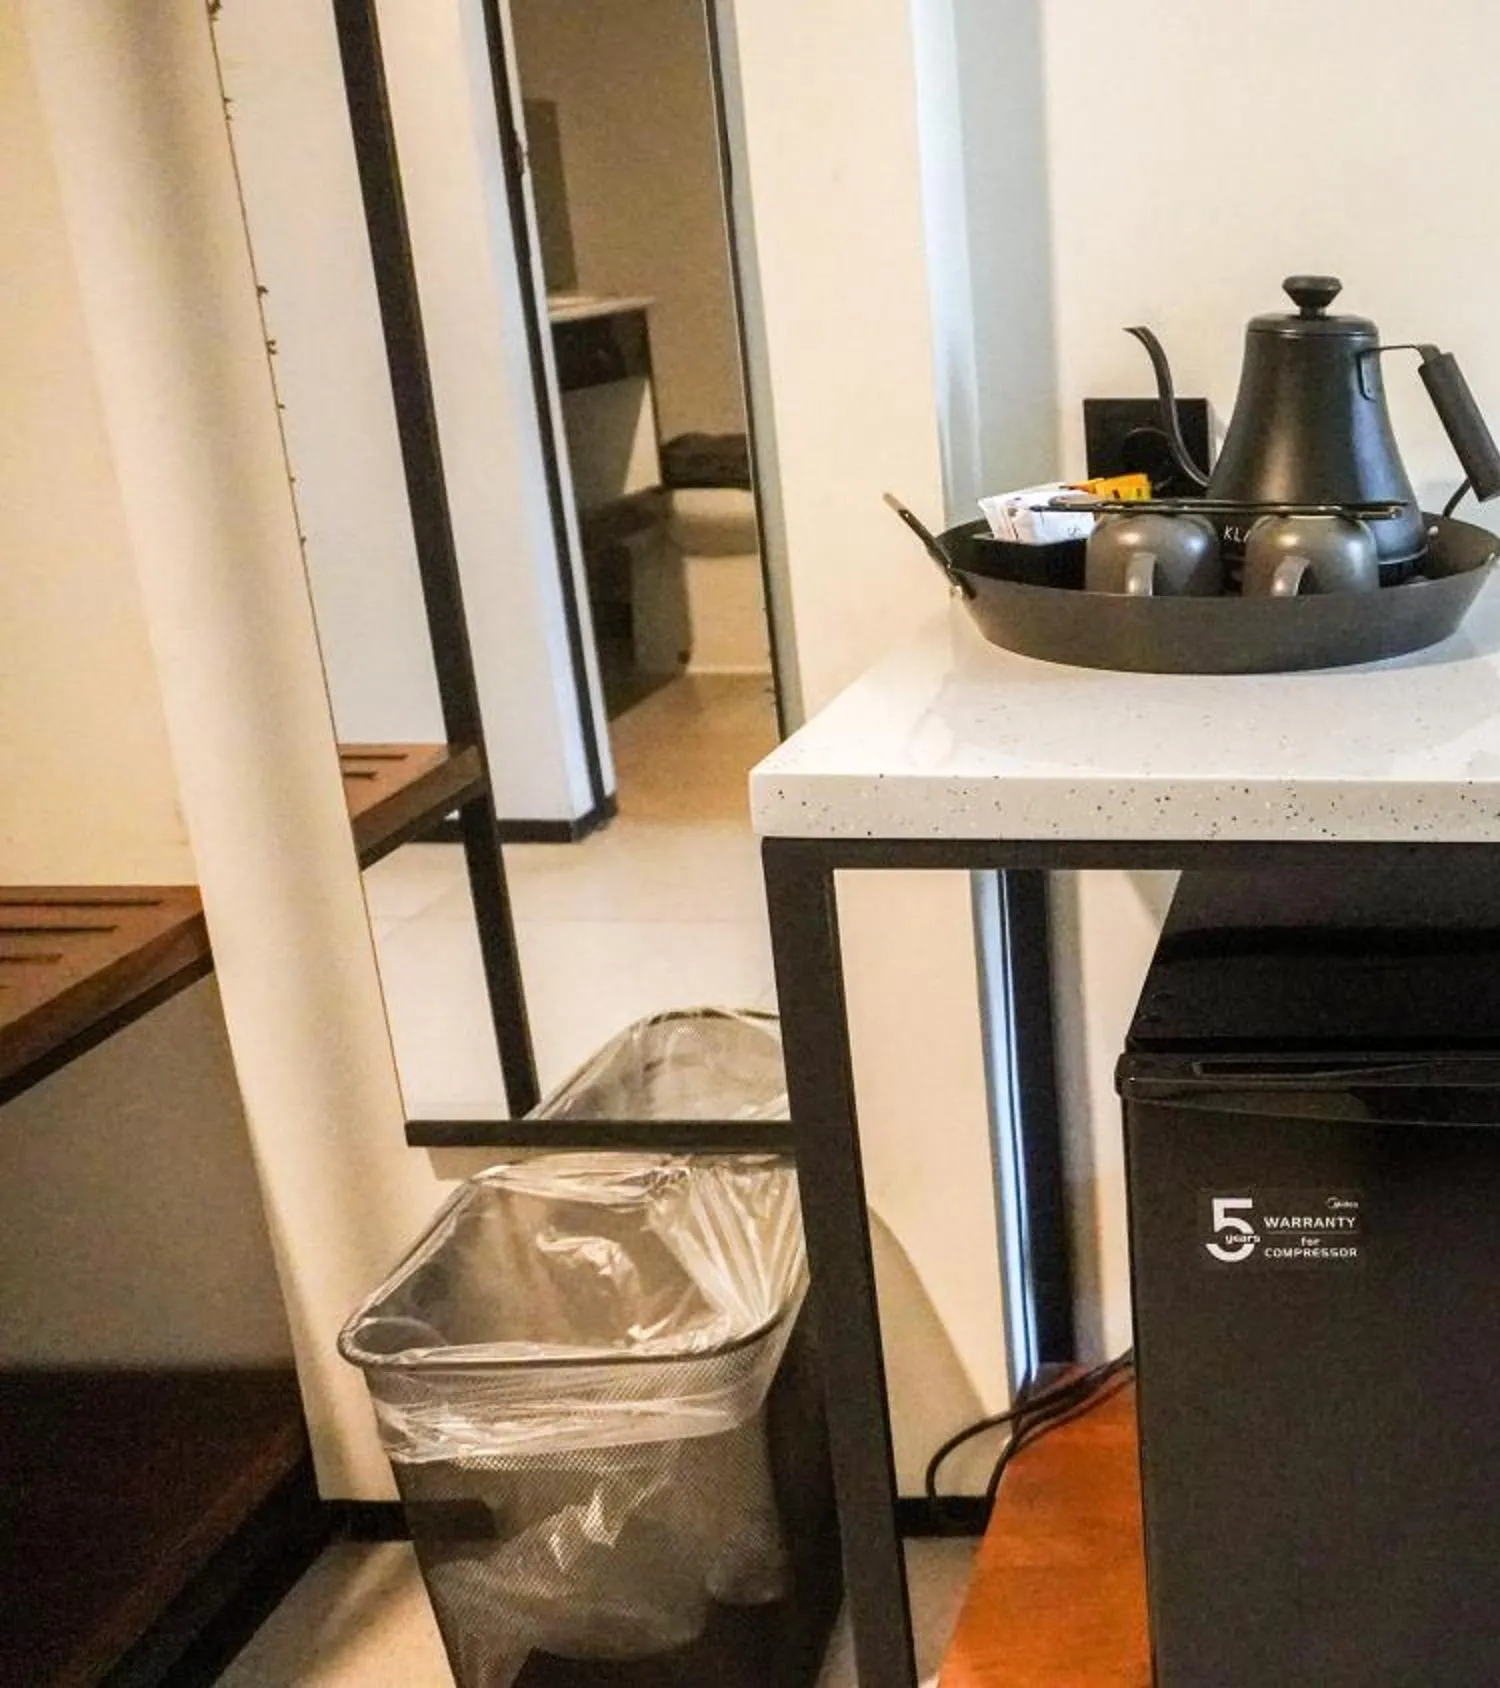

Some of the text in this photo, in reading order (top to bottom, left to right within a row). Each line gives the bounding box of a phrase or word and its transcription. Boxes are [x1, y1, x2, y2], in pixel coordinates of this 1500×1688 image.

[1263, 1216, 1356, 1229] WARRANTY
[1205, 1197, 1256, 1263] 5
[1225, 1234, 1261, 1245] years
[1301, 1237, 1320, 1247] for
[1264, 1247, 1358, 1259] COMPRESSOR
